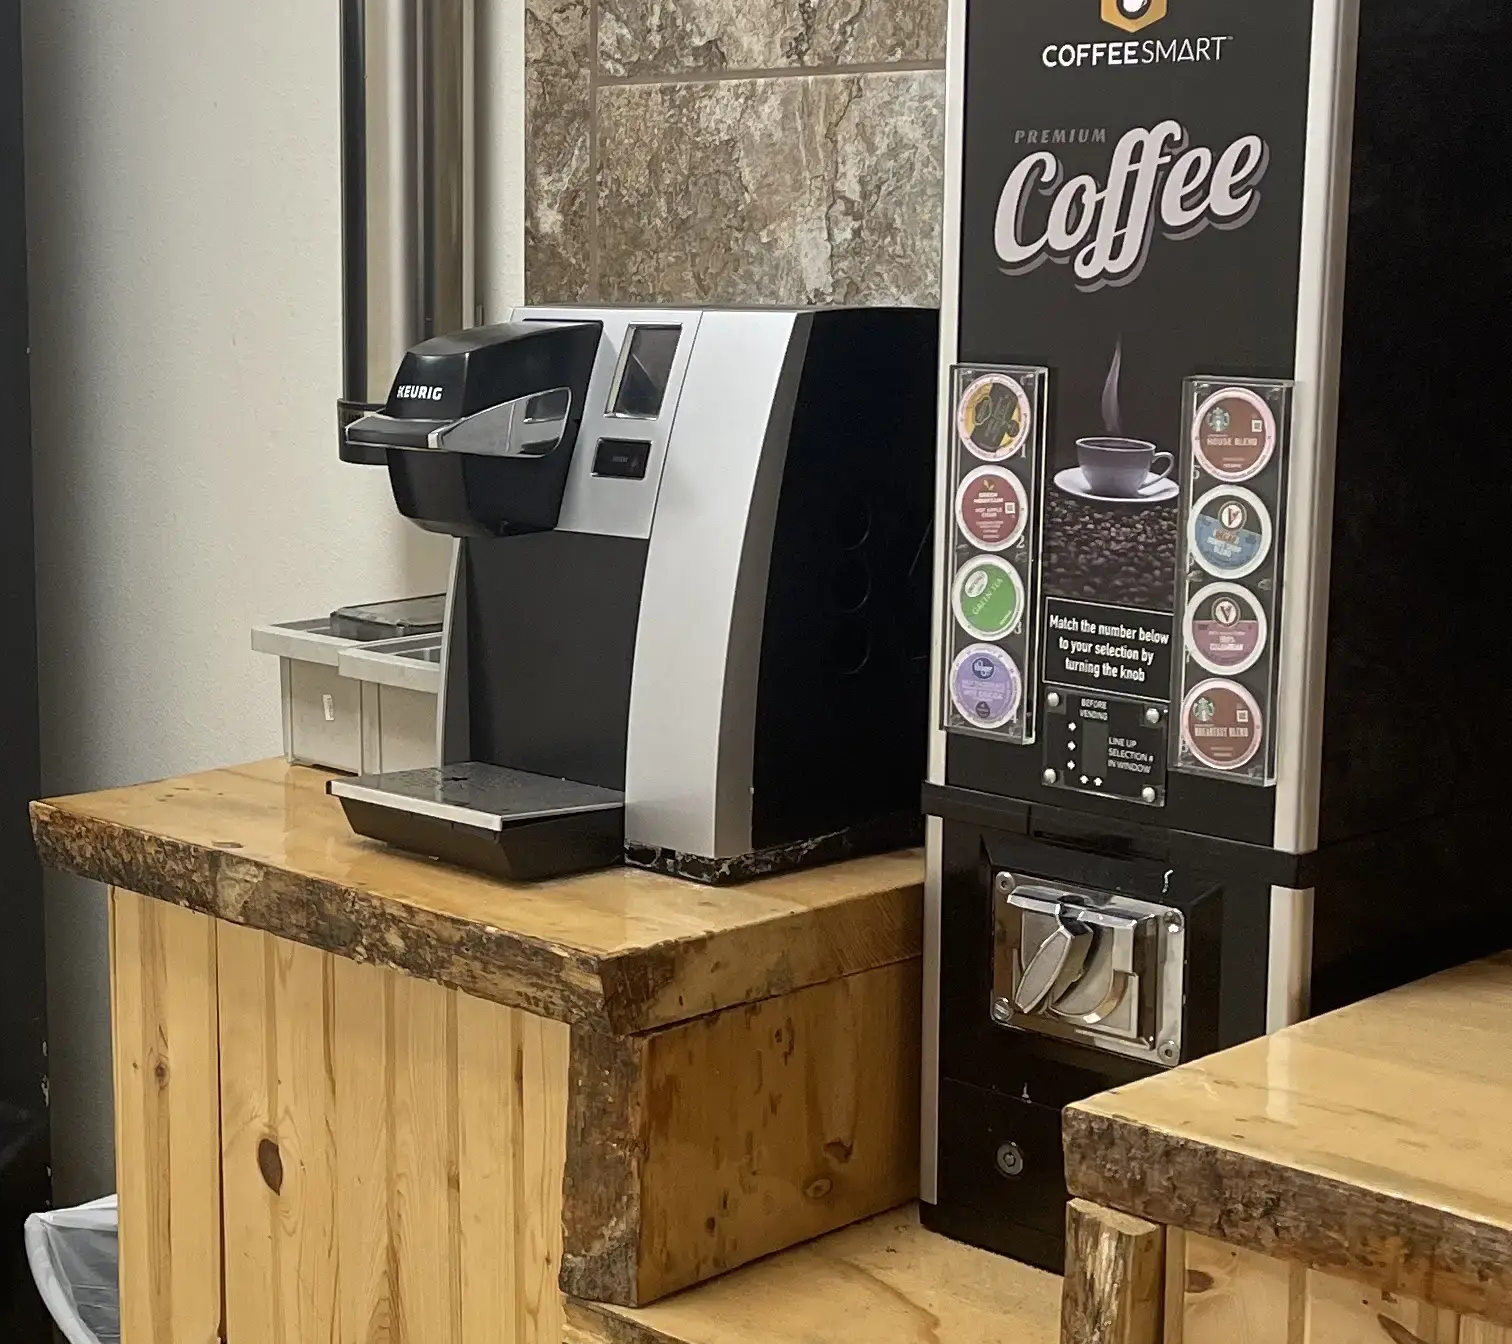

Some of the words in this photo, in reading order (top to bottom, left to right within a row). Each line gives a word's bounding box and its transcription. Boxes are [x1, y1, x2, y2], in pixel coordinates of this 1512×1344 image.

[1013, 128, 1106, 144] PREMIUM
[994, 119, 1268, 290] Coffee
[396, 384, 444, 401] KEURIG
[1049, 614, 1079, 632] Match
[1080, 619, 1096, 634] the
[1098, 624, 1137, 640] number
[1138, 627, 1170, 644] below
[1059, 636, 1069, 650] to
[1070, 640, 1093, 654] your
[1094, 642, 1139, 661] selection
[1141, 647, 1155, 666] by
[1065, 657, 1100, 678] turning
[1102, 662, 1118, 677] the
[1120, 664, 1145, 682] knob
[1080, 698, 1107, 710] BEFORE
[1079, 709, 1108, 721] VENDING
[1108, 736, 1125, 747] LINE
[1126, 739, 1137, 748] UP
[1108, 747, 1148, 762] SELECTION
[1108, 759, 1117, 768] IN
[1117, 761, 1152, 774] WINDOW
